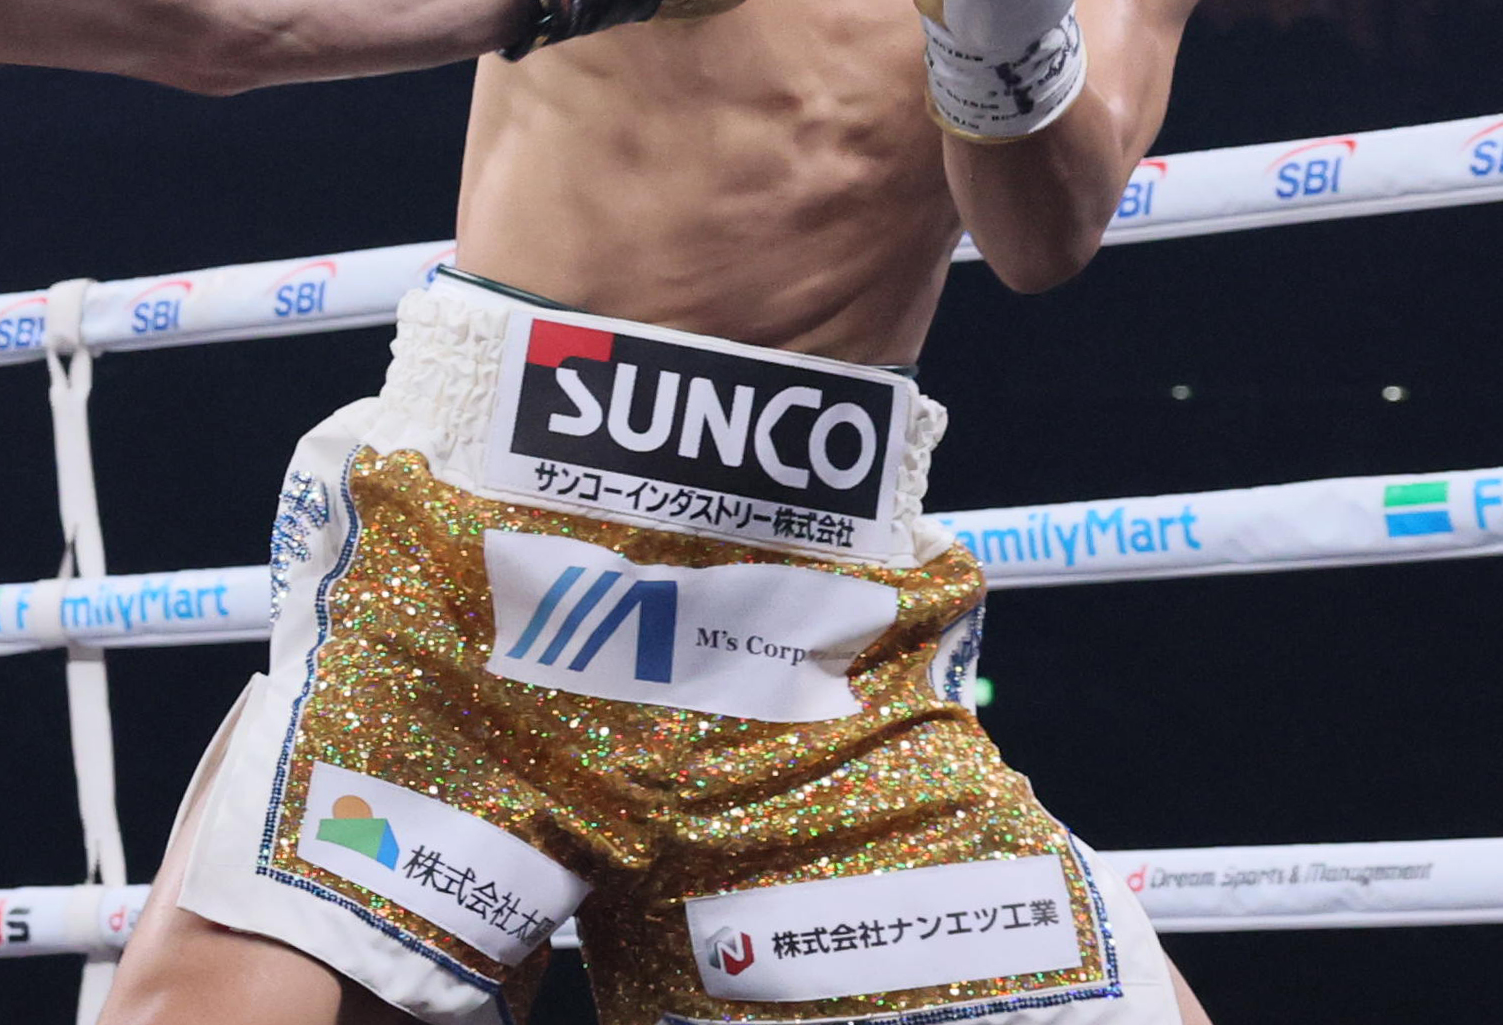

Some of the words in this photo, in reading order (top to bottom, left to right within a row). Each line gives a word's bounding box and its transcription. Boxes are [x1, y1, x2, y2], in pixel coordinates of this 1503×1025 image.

[1118, 180, 1154, 217] BI
[1275, 157, 1343, 200] SBI
[132, 300, 180, 333] SBI
[274, 280, 326, 317] SBI
[548, 362, 878, 490] SUNCO
[535, 461, 855, 548] サンコーインダストリー株式会社
[939, 505, 1202, 567] amilyMart
[16, 578, 229, 630] FmilyMart
[771, 899, 1060, 960] 株式会社ナンエツ工業
